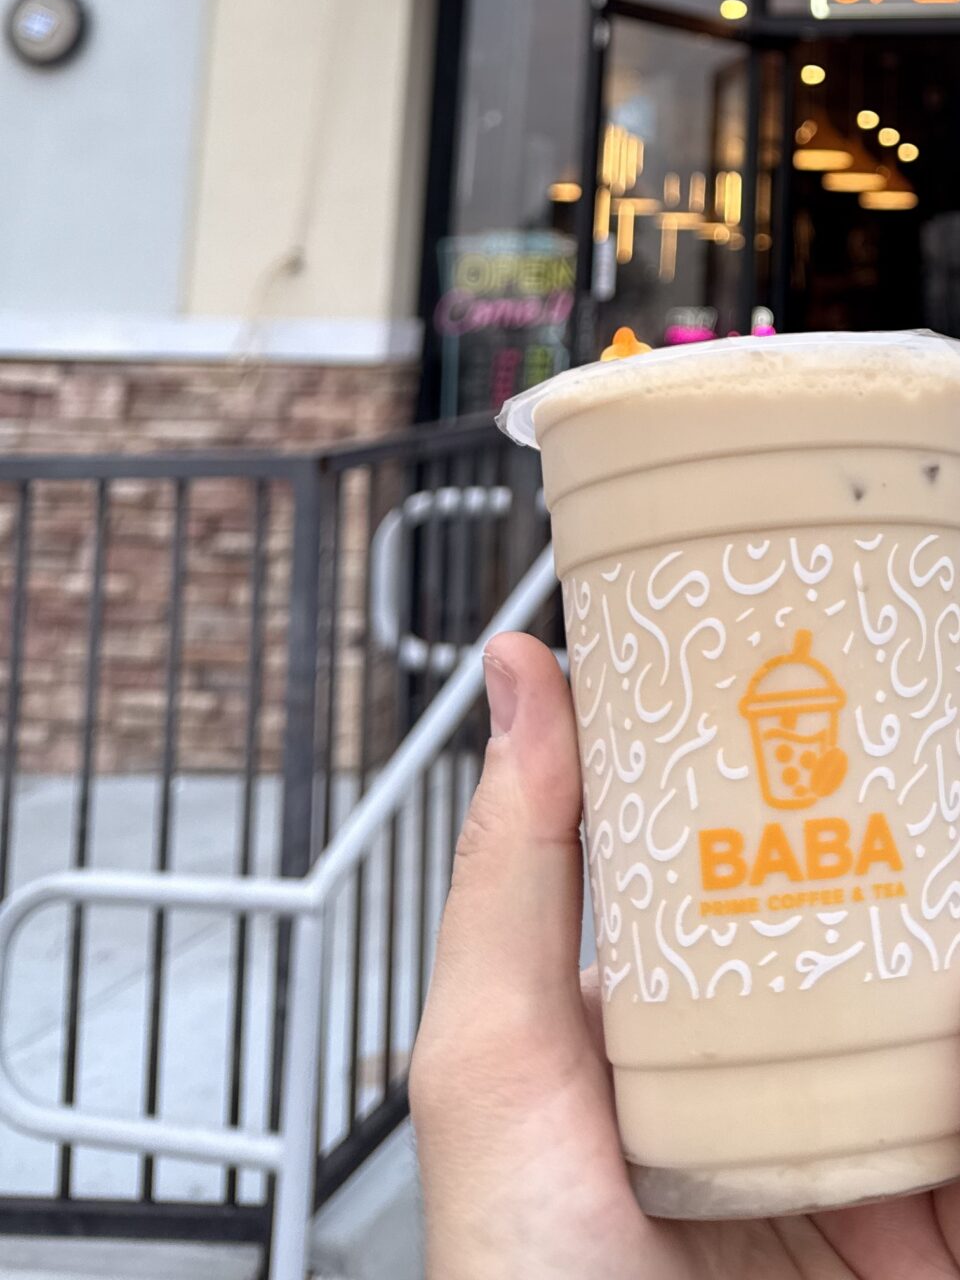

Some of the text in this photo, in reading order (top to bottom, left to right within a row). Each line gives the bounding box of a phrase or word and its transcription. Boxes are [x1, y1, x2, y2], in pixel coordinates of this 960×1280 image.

[697, 812, 905, 891] BABA
[767, 888, 845, 911] COFFEE
[872, 881, 908, 900] TEA
